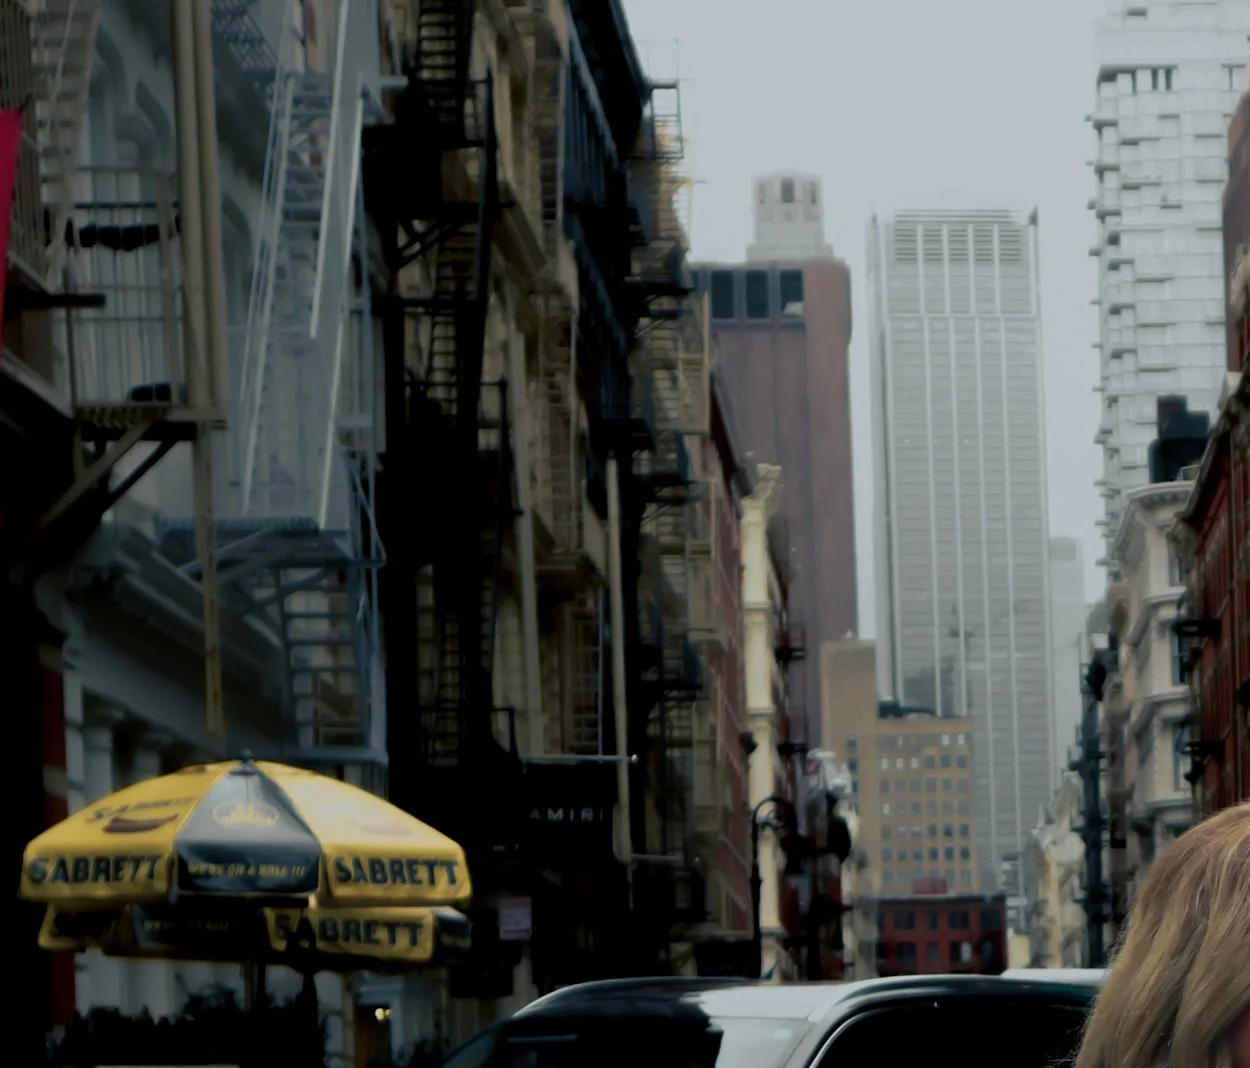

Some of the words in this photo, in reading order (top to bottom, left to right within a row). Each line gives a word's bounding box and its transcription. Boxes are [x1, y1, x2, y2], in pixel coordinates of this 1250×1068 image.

[529, 807, 604, 822] AMIRI
[29, 855, 161, 884] SABRETT
[334, 856, 459, 886] SABRETT
